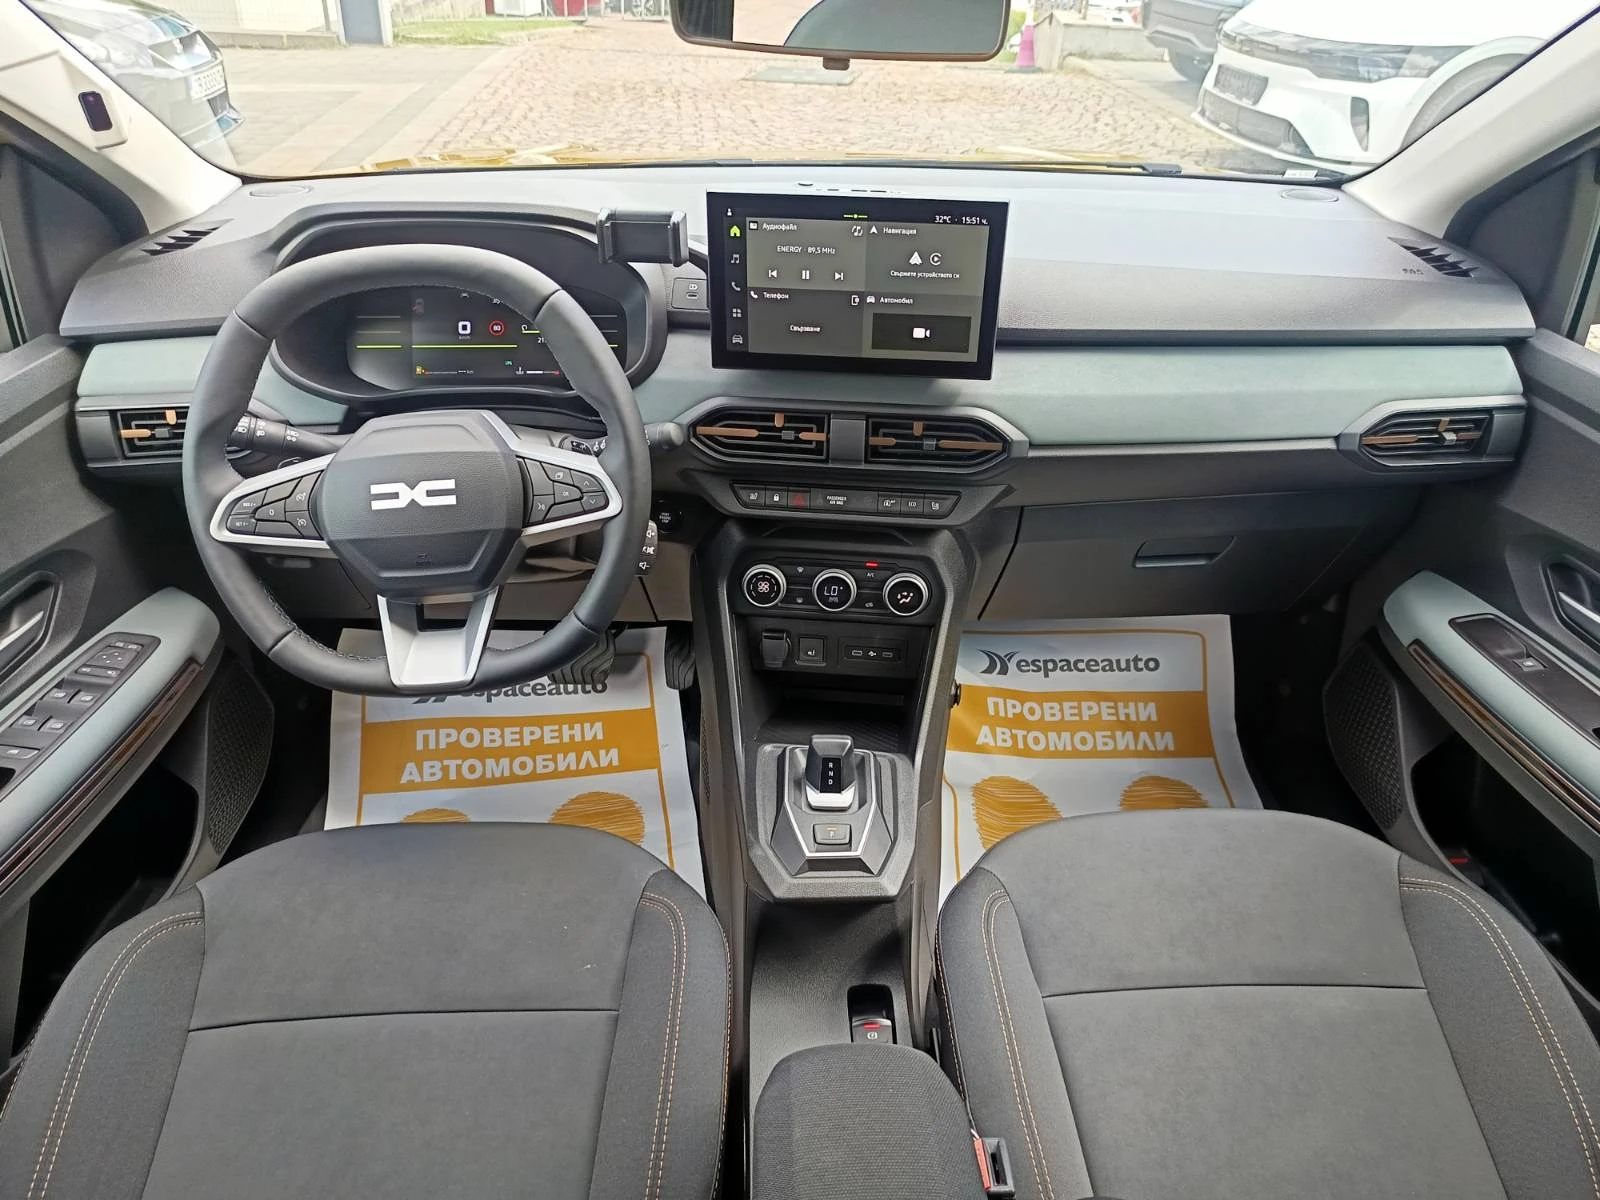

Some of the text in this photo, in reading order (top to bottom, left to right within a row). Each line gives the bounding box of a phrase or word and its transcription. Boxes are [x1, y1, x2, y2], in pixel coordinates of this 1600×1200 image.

[961, 216, 980, 224] 15:51
[762, 222, 798, 232] Аудиофайл
[883, 227, 917, 236] Навигация
[777, 245, 802, 253] ENERGY
[763, 291, 789, 300] Телефон
[879, 296, 914, 304] Автомобил
[1015, 653, 1161, 678] espaceauto
[987, 697, 1158, 722] ПРОВЕРЕНИ
[415, 721, 604, 751] ПРОВЕРЕНИ
[976, 725, 1175, 751] АВТОМОБИЛИ
[400, 747, 619, 784] АВТОМОБИЛИ
